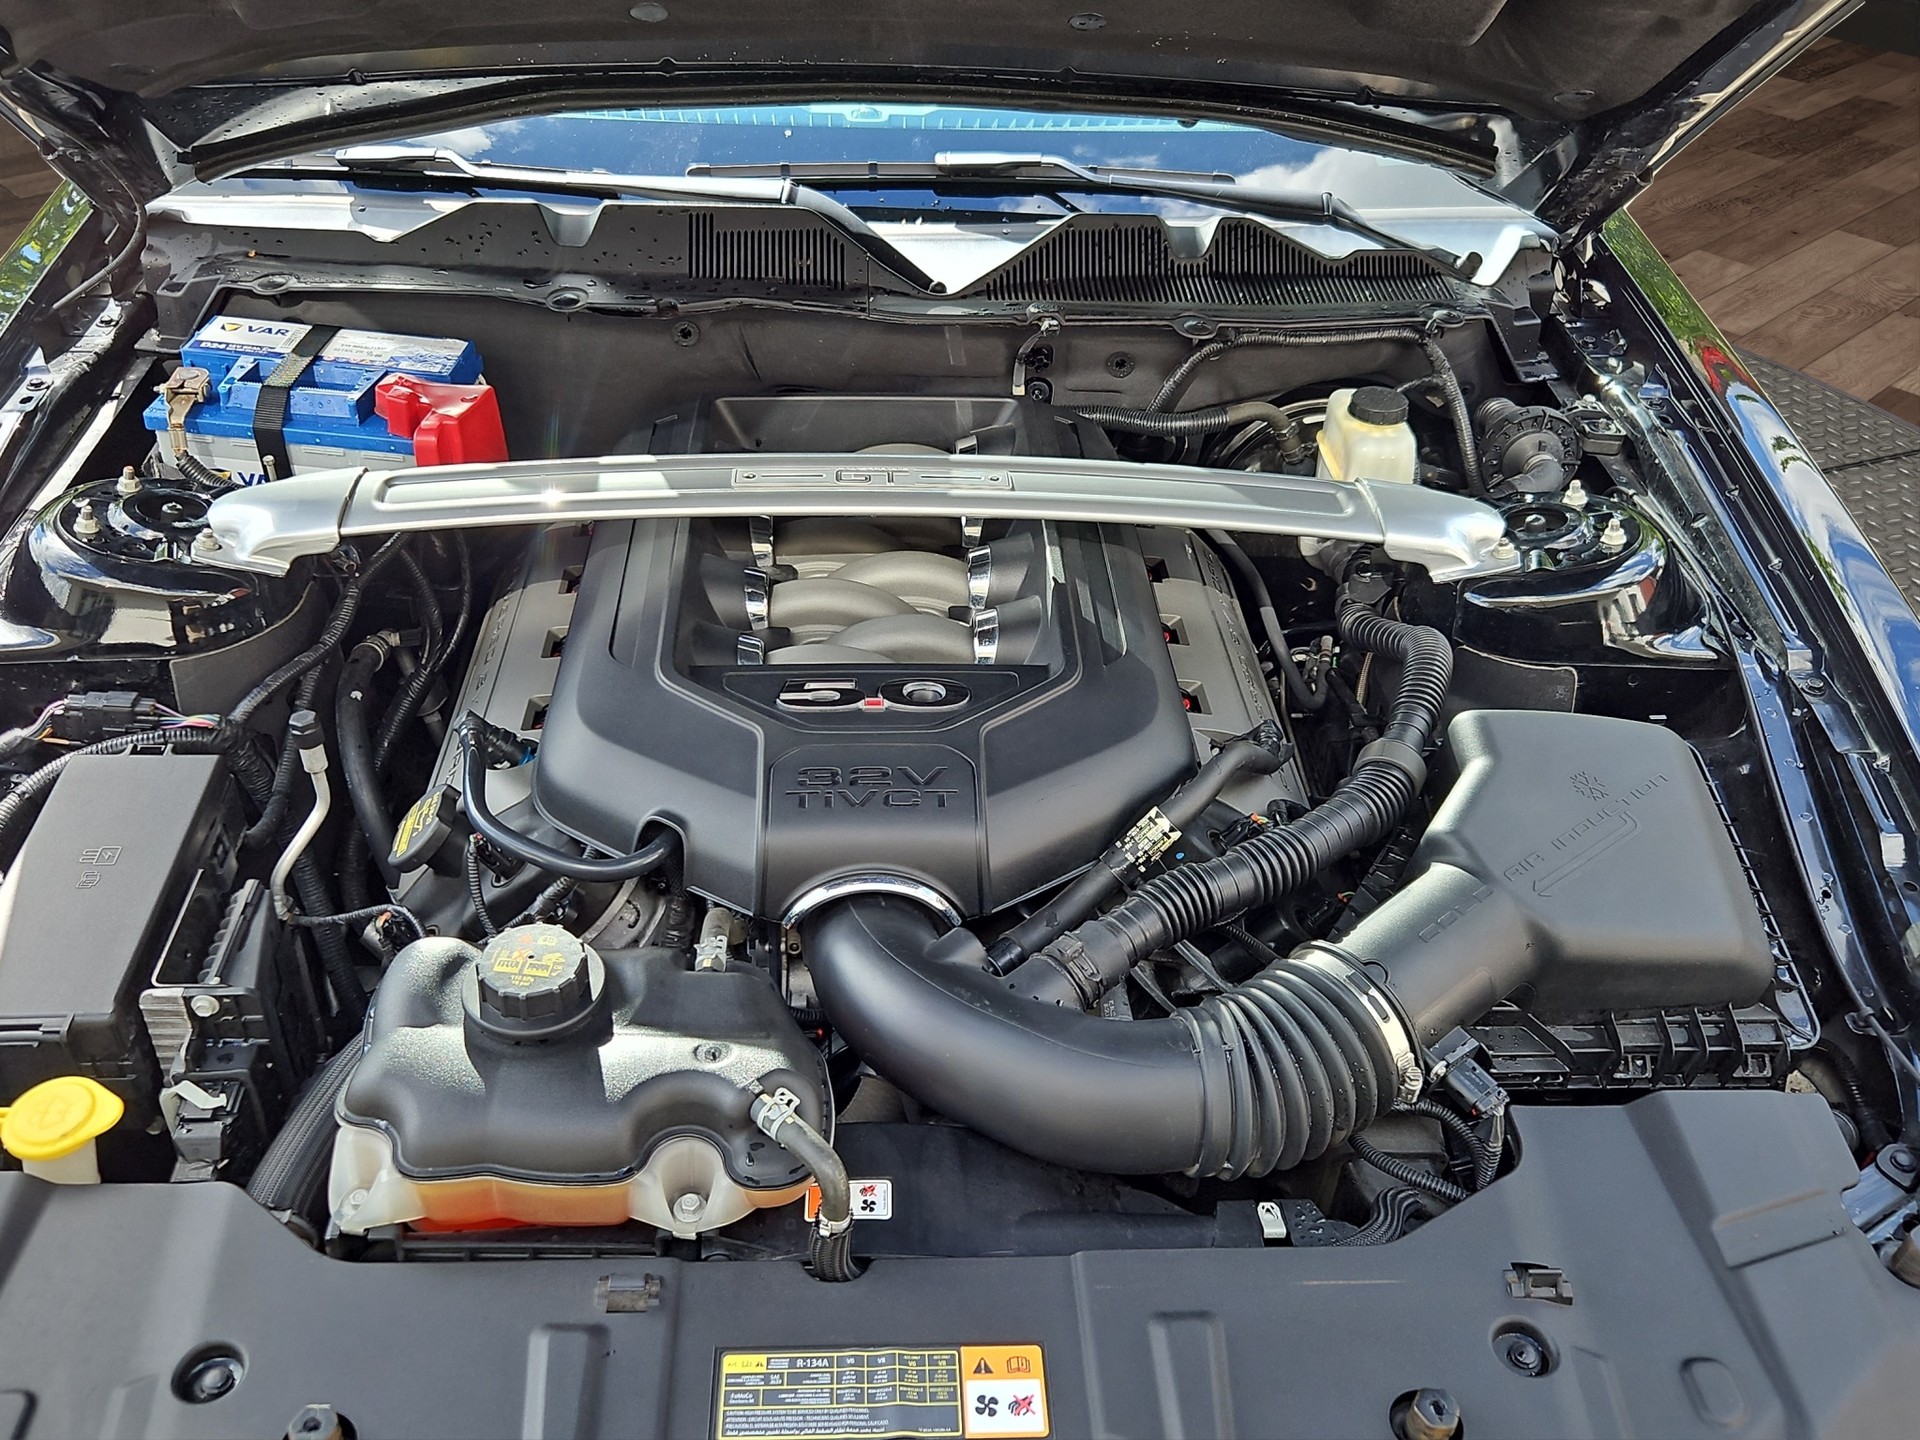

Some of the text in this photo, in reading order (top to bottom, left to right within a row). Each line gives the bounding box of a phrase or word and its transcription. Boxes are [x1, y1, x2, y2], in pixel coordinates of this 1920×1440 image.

[247, 325, 290, 337] VAR
[835, 469, 909, 485] GT
[776, 678, 972, 713] 5.0
[797, 766, 949, 787] 32V
[1418, 773, 1669, 944] COLD AIR INDUCTION
[796, 1358, 830, 1368] R-134A
